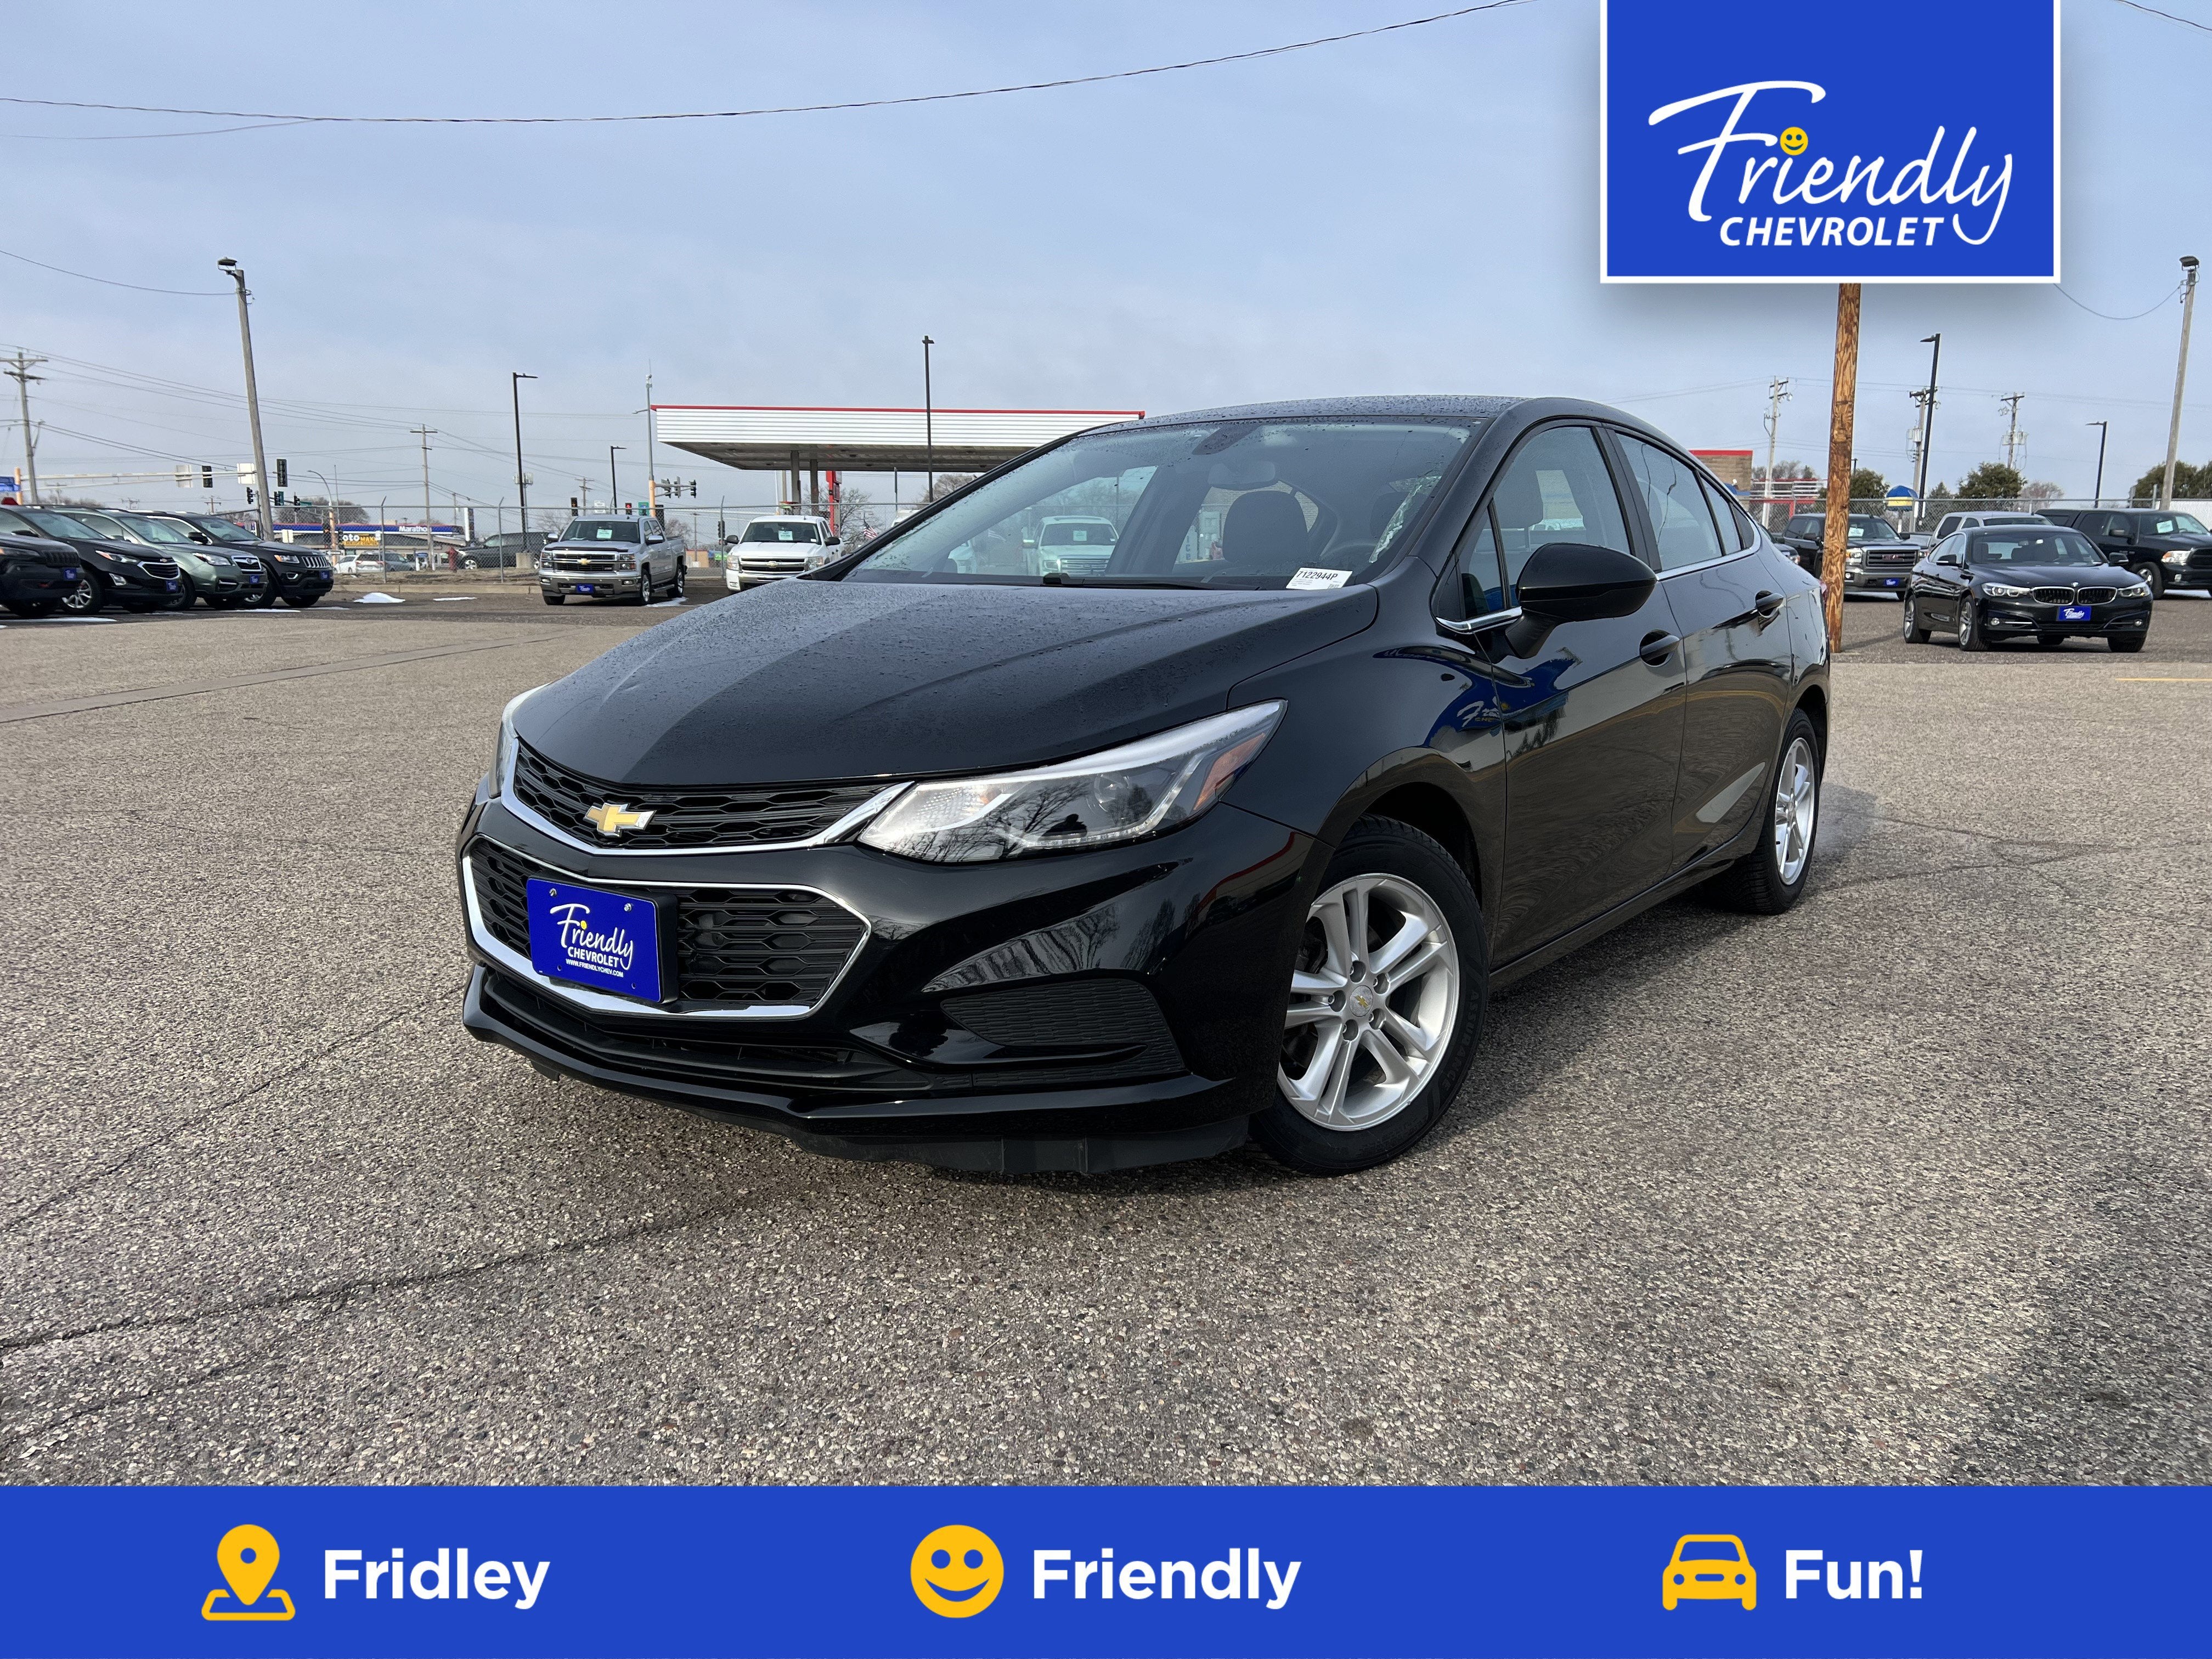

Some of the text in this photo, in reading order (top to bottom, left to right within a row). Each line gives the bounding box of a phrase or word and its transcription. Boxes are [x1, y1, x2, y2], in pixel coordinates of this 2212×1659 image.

[1296, 571, 1338, 580] 7122944P
[550, 903, 634, 970] Friendly
[566, 958, 624, 978] WWW.FRIENDLYCHEV.COM
[567, 946, 619, 968] CHEVROLET
[1441, 991, 1480, 1092] ASSURANCE
